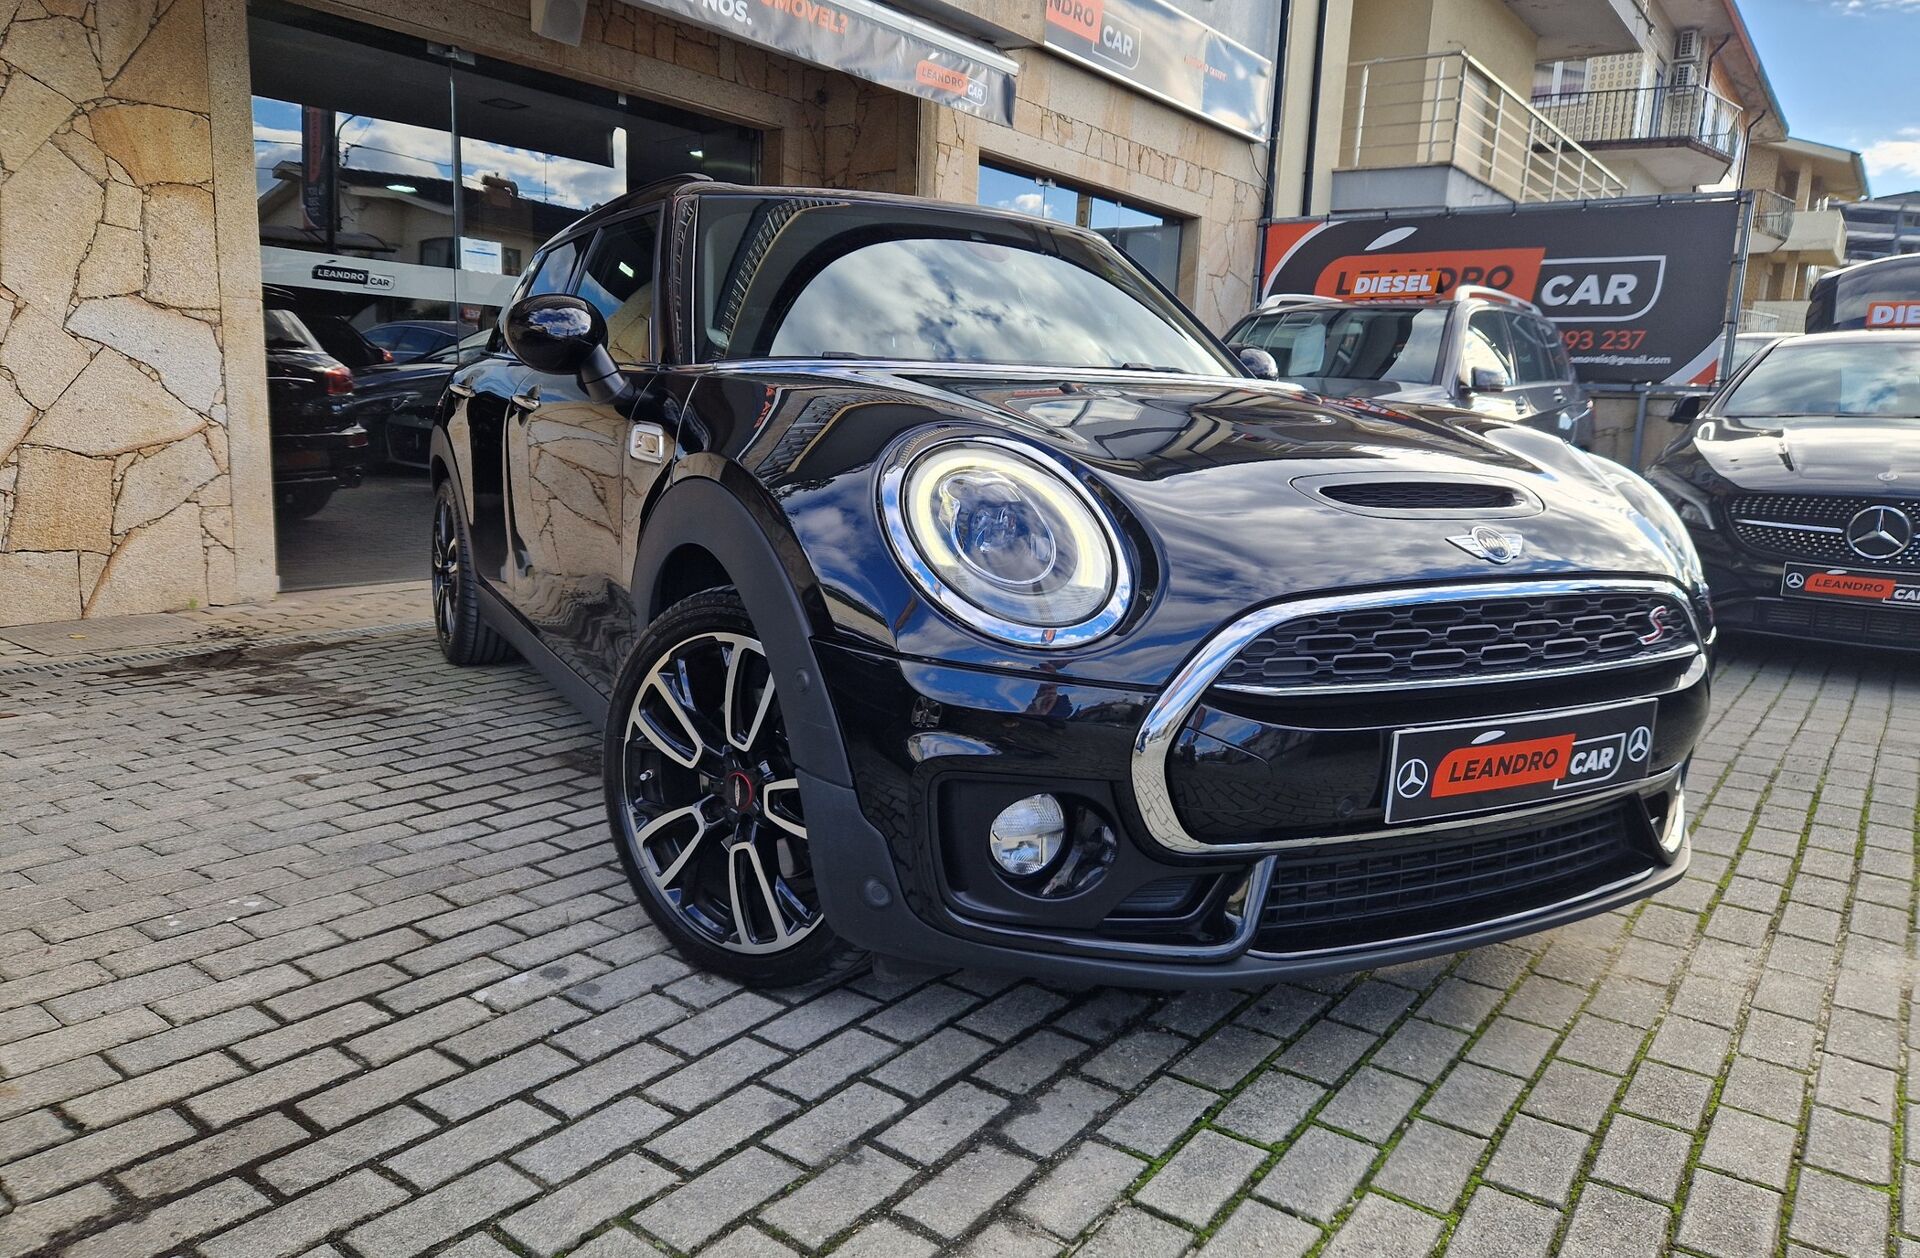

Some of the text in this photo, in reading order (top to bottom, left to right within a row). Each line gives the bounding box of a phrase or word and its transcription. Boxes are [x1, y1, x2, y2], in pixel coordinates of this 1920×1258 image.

[1103, 25, 1133, 57] CAR
[922, 67, 983, 100] LEANDRO CAR
[317, 268, 390, 287] LEANDRO CAR
[1335, 265, 1638, 306] LDRO CAR
[1354, 274, 1433, 294] DIESEL
[1559, 330, 1647, 350] 93 237
[1815, 578, 1884, 593] LEANDRO
[1637, 606, 1667, 646] S
[1448, 747, 1615, 783] LEANDRO CAR
